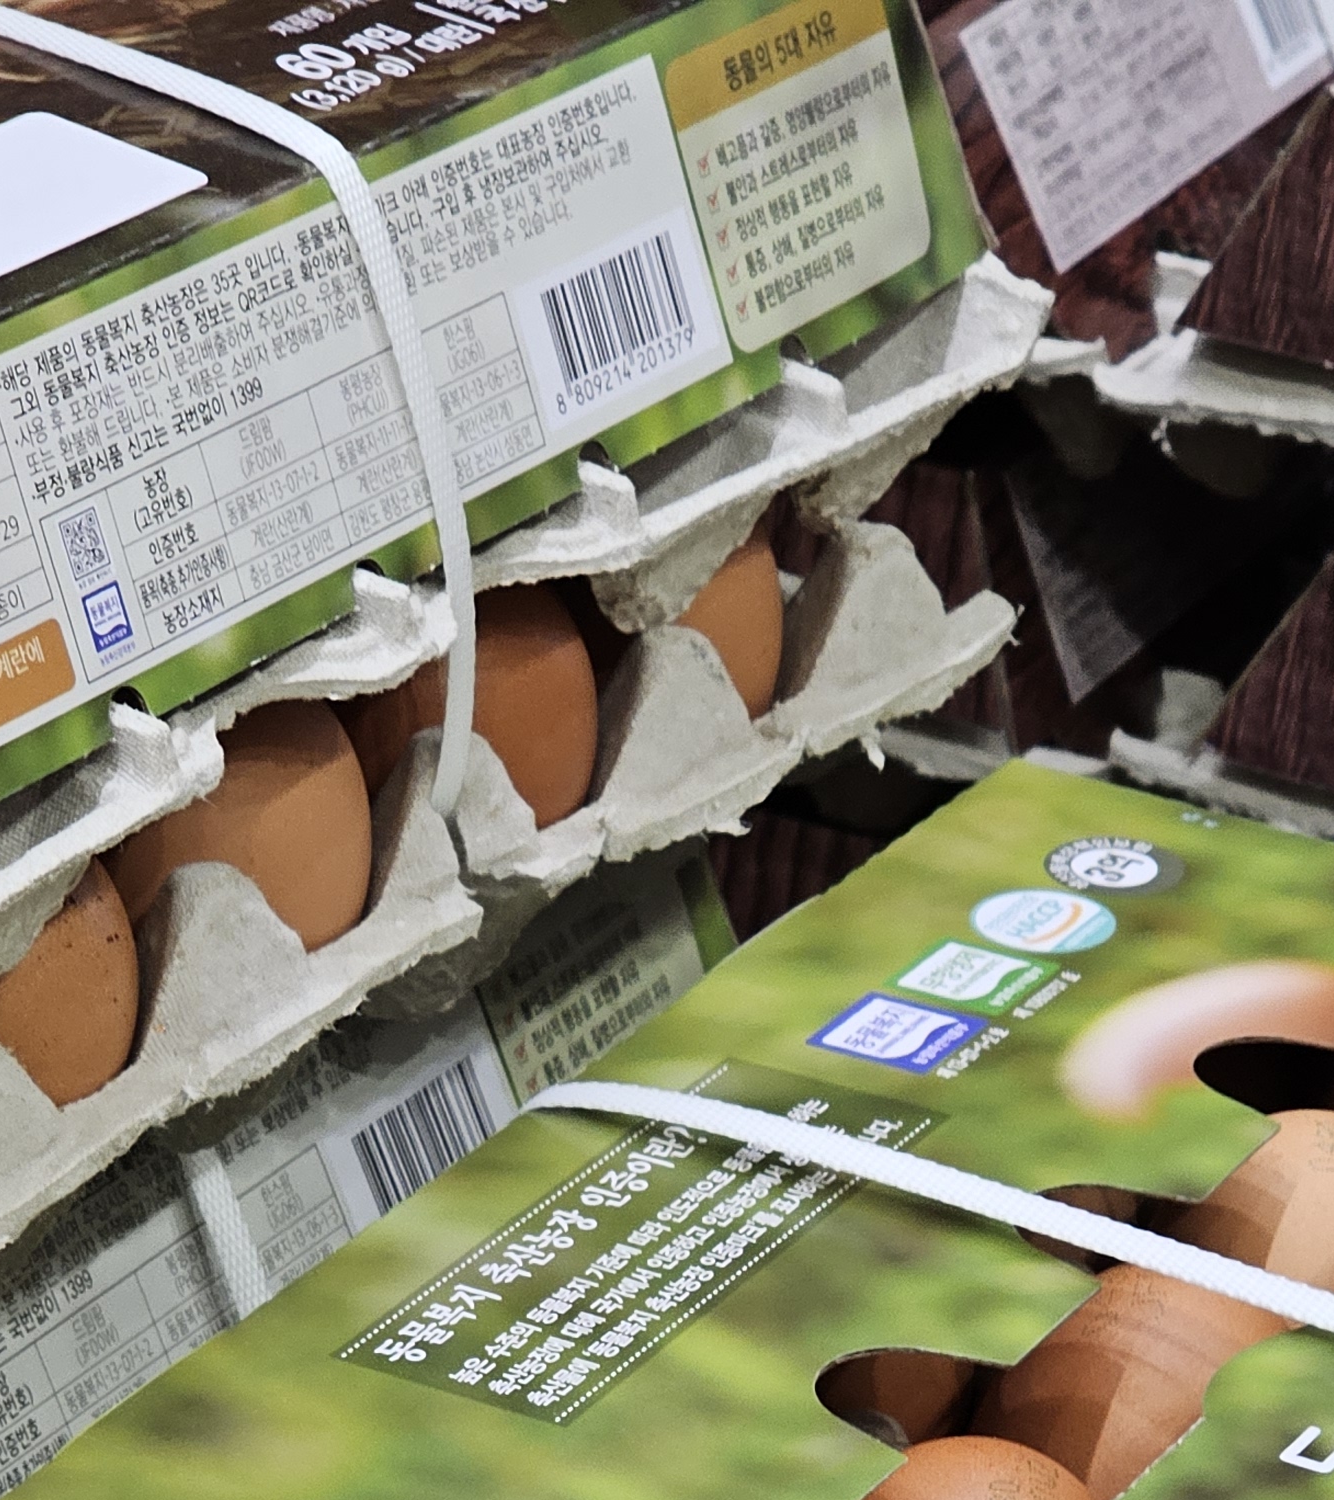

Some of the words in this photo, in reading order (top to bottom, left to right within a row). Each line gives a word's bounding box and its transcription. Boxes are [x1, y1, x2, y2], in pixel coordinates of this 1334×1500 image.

[274, 42, 357, 80] 60
[723, 40, 775, 93] 동물의
[774, 27, 805, 66] 5대
[803, 10, 837, 48] 자유
[33, 337, 80, 376] 제품의
[80, 309, 139, 359] 동물복지
[210, 262, 244, 296] 35곳
[42, 358, 103, 408] 동물복지
[103, 330, 161, 376] 축산농장
[161, 316, 192, 351] 인증
[192, 299, 236, 336] 정보는
[556, 393, 567, 415] 8
[573, 360, 632, 407] 809214
[639, 334, 694, 375] 201379
[127, 424, 170, 461] 신고는
[170, 392, 228, 436] 국번없이
[229, 376, 264, 409] 1399
[142, 466, 170, 500] 농장
[148, 521, 200, 566] 인증번호
[161, 582, 225, 635] 농장소재지
[60, 1267, 94, 1303] 1399
[373, 1282, 503, 1363] 동물복지
[477, 1208, 598, 1285] 축산농장
[579, 1125, 708, 1208] 인증이란?
[484, 1320, 543, 1359] 수준의
[525, 1276, 600, 1325] 동물복지
